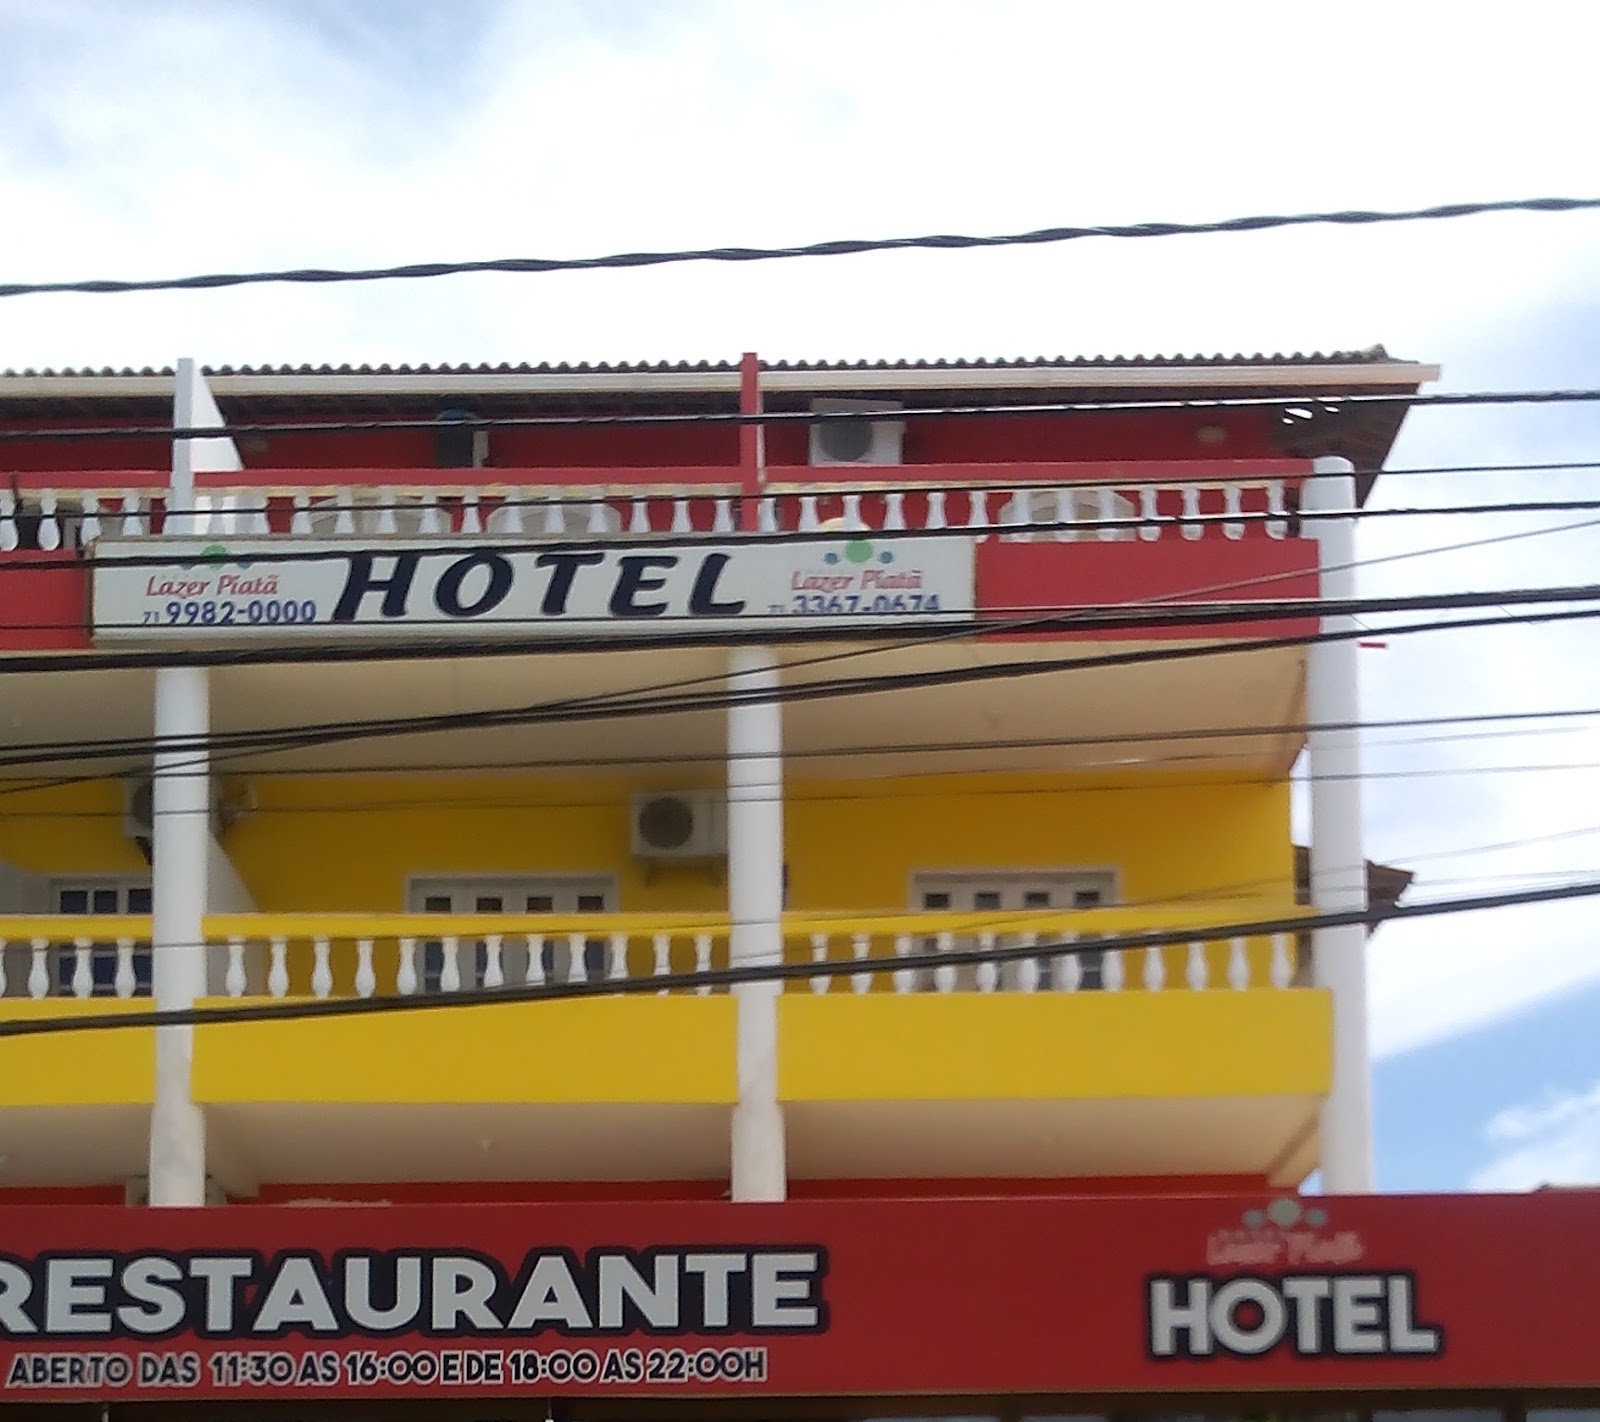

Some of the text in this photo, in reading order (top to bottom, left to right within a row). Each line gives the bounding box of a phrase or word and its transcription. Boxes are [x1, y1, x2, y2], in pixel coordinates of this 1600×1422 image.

[146, 574, 211, 599] Lazer
[166, 600, 317, 624] 9982-0000
[330, 550, 747, 624] HOTEL
[0, 1252, 820, 1334] RESTAURANTE
[1149, 1274, 1441, 1356] HOTEL
[8, 1354, 131, 1385] ABERTO
[140, 1353, 199, 1384] DAS
[211, 1353, 293, 1384] 11:30
[299, 1353, 339, 1384] AS
[345, 1352, 437, 1383] 16:00
[509, 1350, 598, 1382] 18:00
[602, 1350, 643, 1381] AS
[647, 1347, 767, 1381] 22:00H
